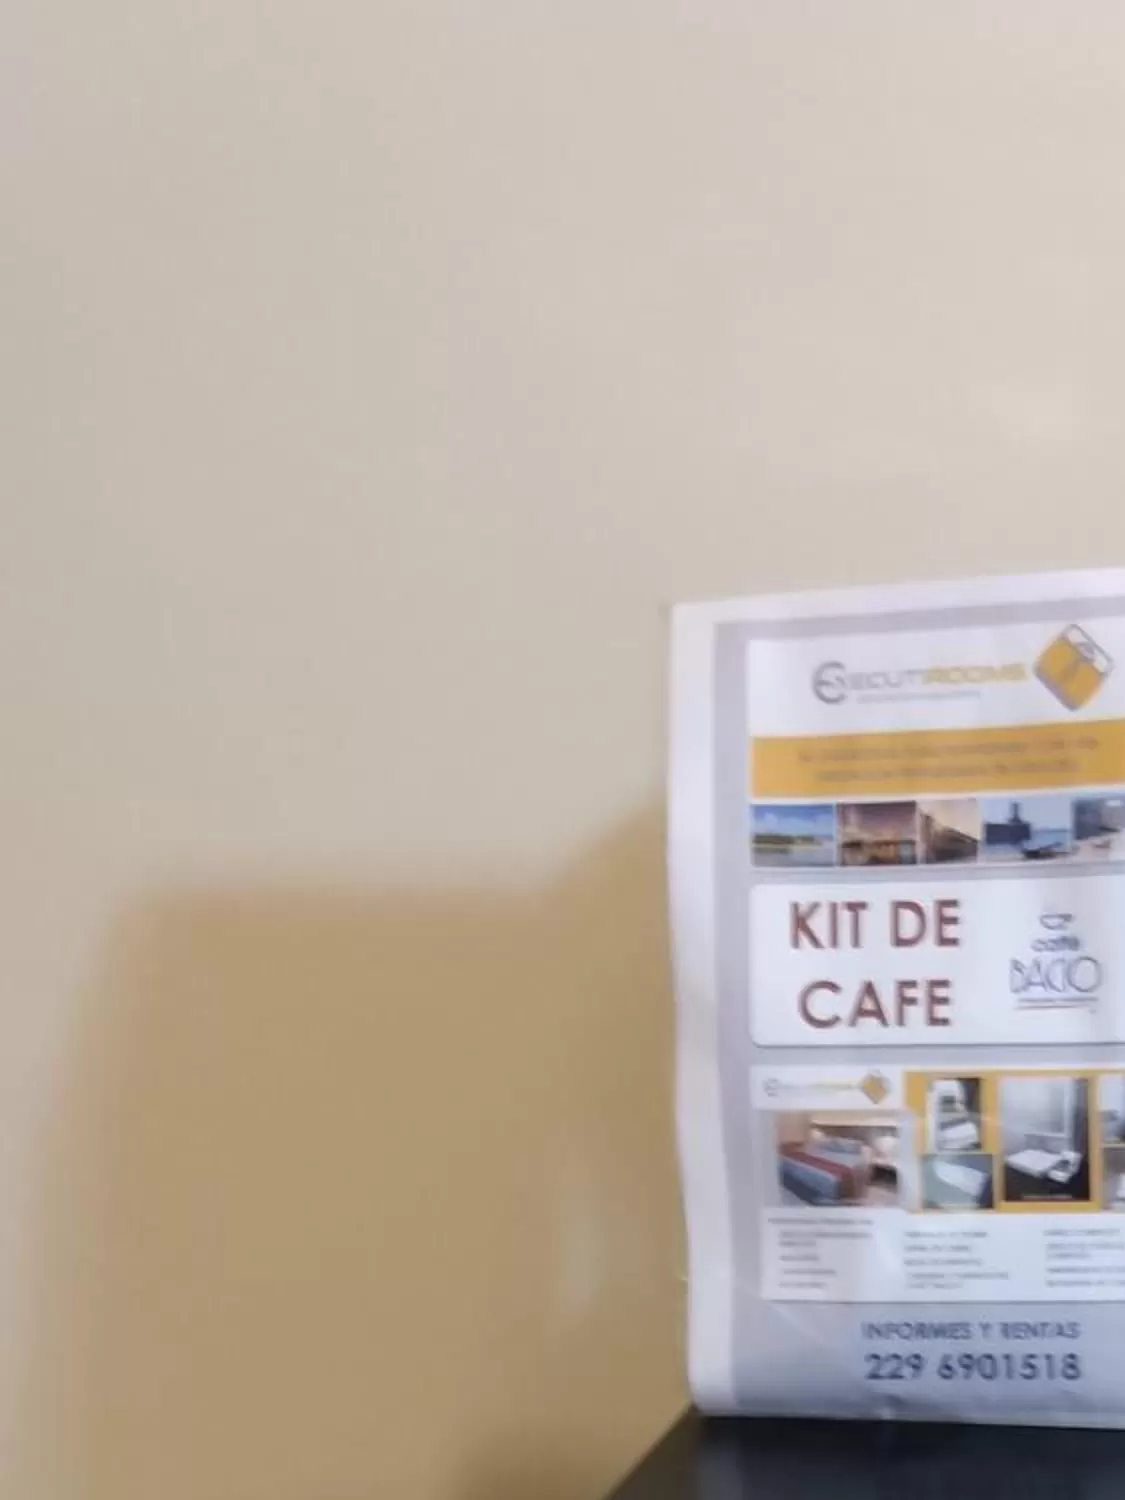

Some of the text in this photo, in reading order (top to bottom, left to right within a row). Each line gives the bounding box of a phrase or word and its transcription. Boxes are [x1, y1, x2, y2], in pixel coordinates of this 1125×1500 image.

[789, 899, 961, 949] KIT DE
[797, 979, 952, 1029] CAFE
[861, 1321, 1081, 1340] INFORMES Y RENTAS
[864, 1352, 1082, 1381] 229 6901518
